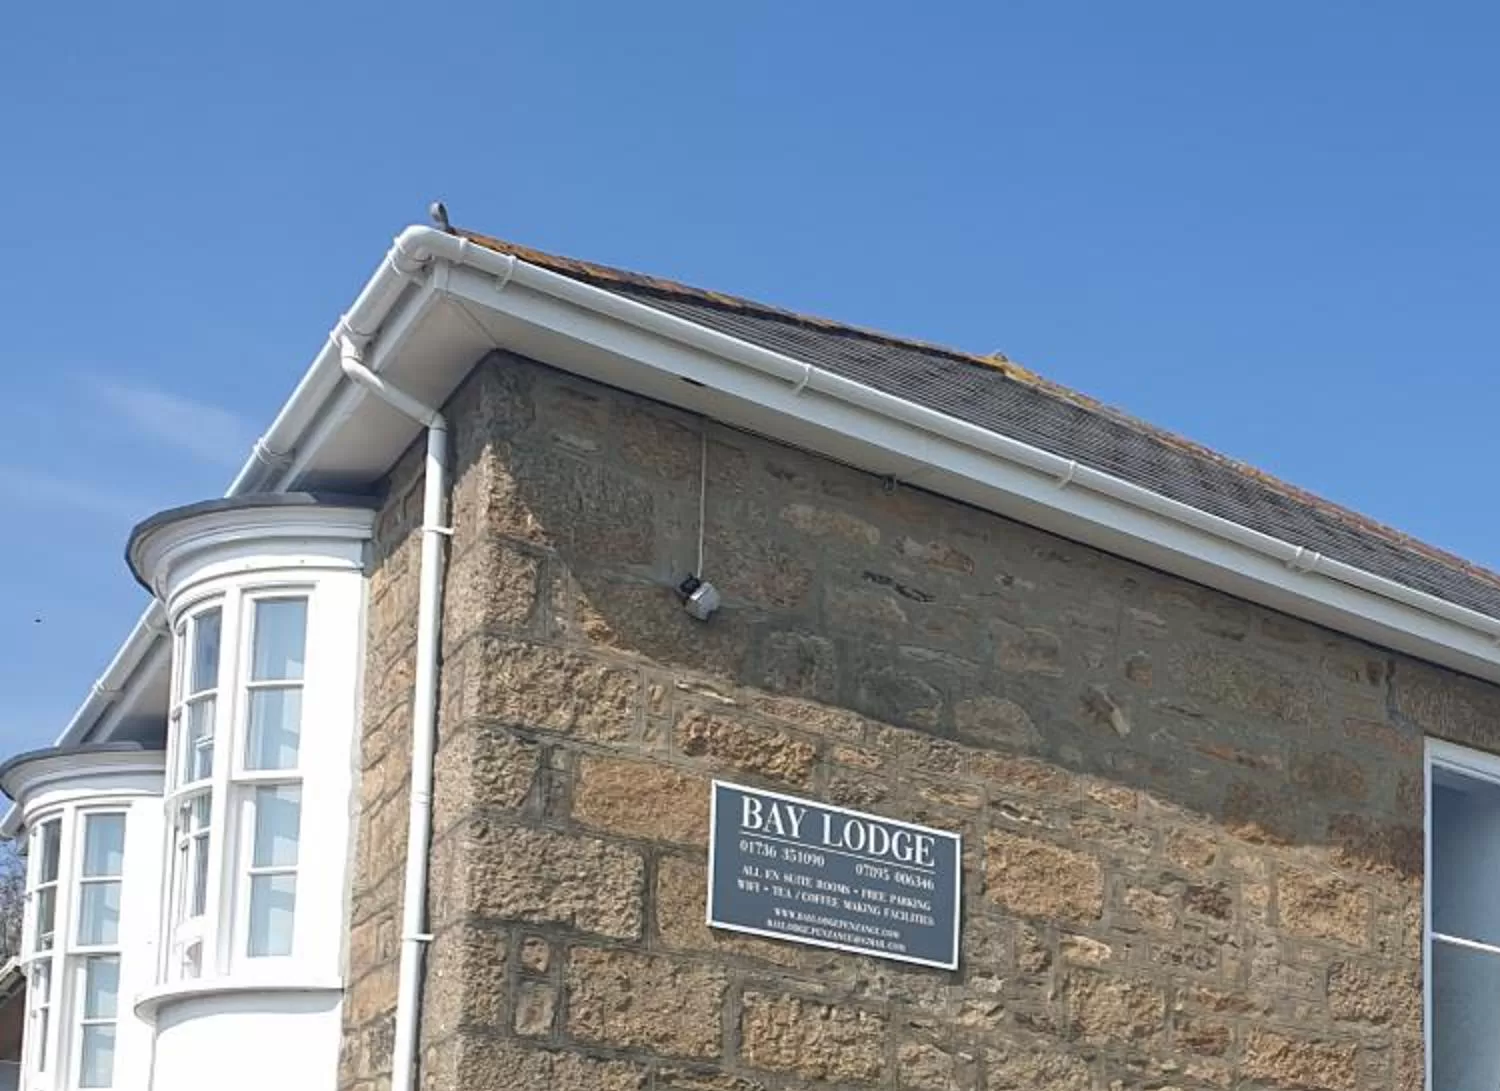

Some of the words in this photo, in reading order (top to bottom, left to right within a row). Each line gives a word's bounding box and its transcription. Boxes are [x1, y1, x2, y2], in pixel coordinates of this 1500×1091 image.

[741, 795, 808, 839] BAY
[822, 813, 936, 867] LODGE
[739, 839, 778, 859] 01736
[781, 847, 825, 868] 351090
[743, 865, 761, 878] ALL
[765, 869, 779, 881] EN
[783, 873, 813, 889] SUITE
[816, 879, 851, 895] ROOMS
[861, 888, 887, 902] FREE
[889, 893, 931, 912] PARKING
[772, 885, 792, 899] TEA
[843, 899, 881, 917] MAKING
[883, 907, 935, 926] FACILITIES
